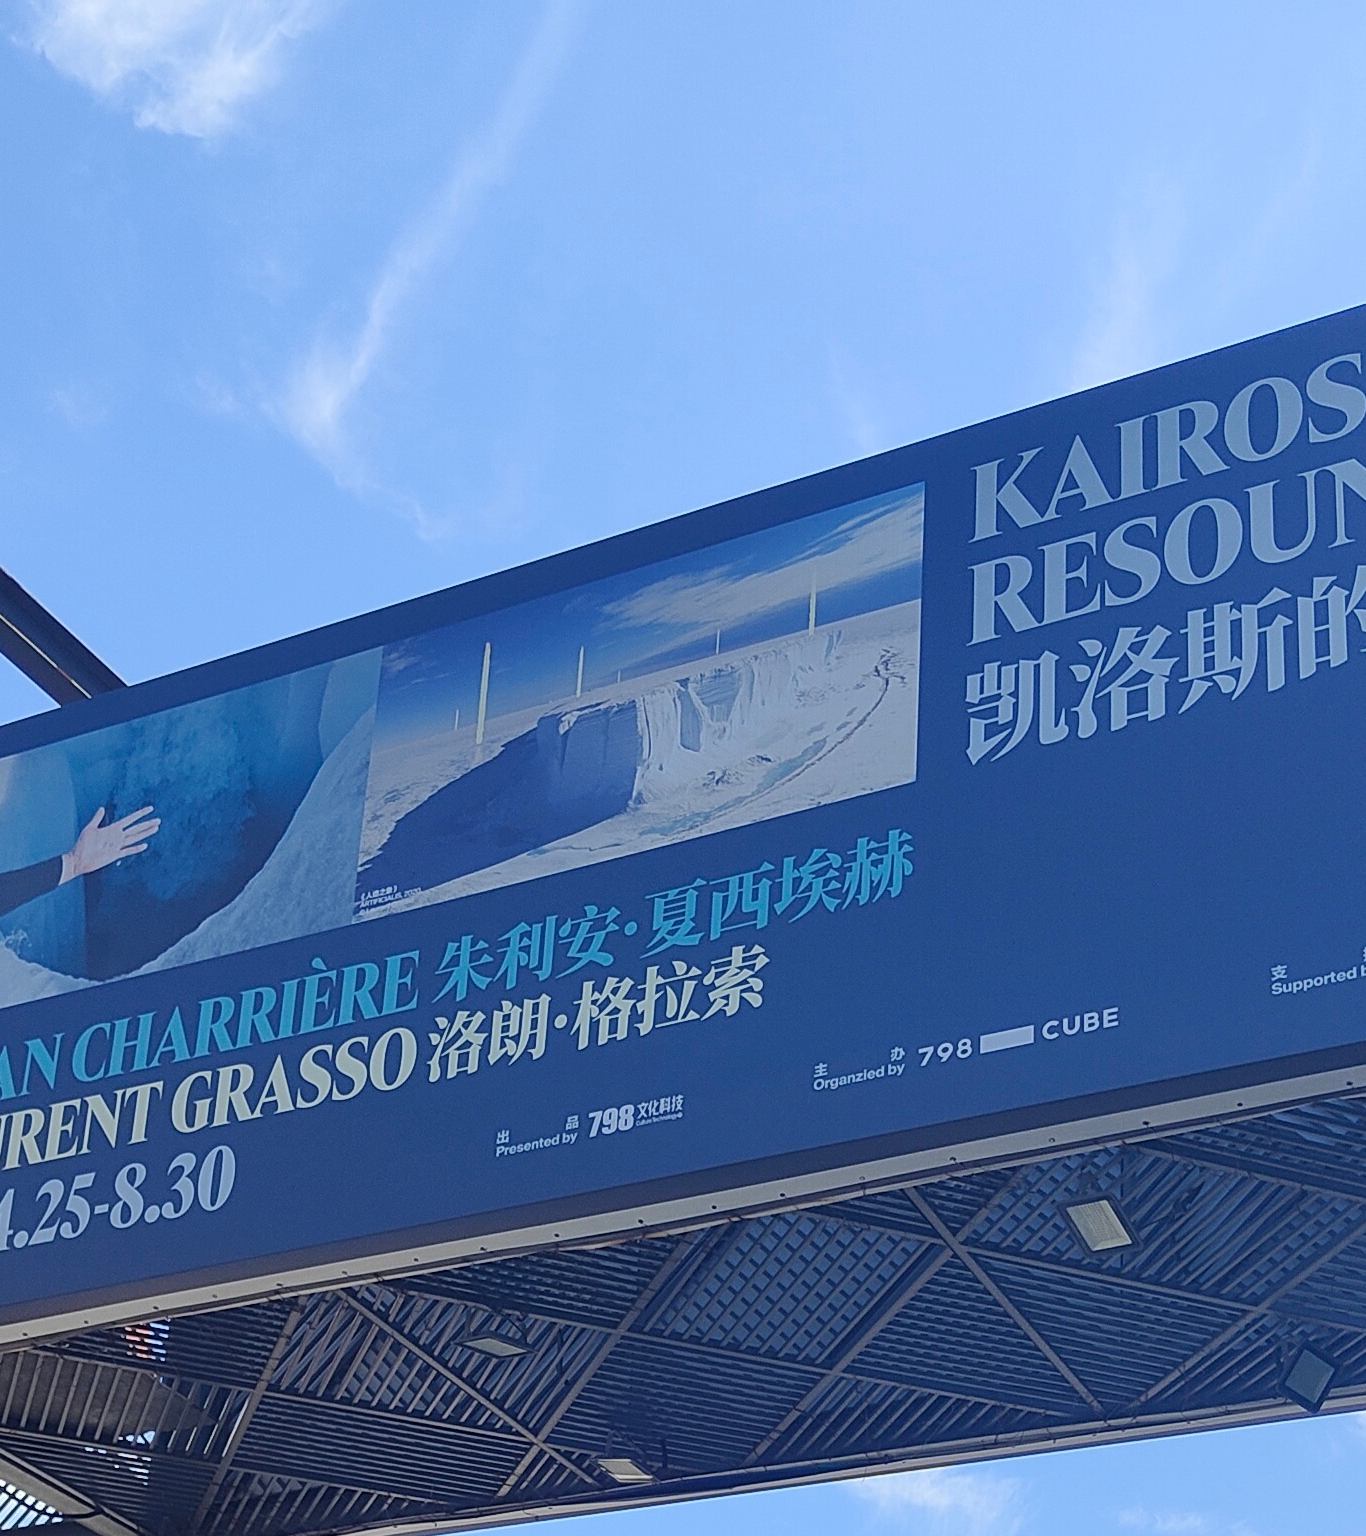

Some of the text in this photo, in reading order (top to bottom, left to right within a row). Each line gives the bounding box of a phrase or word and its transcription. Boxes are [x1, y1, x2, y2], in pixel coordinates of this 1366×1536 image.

[1271, 966, 1357, 995] Supported
[72, 950, 420, 1082] CHARRIÈRE
[427, 944, 770, 1083] 洛朗·格拉索
[918, 1007, 1120, 1067] 798 CUBE
[171, 1027, 418, 1133] GRASSO
[813, 1061, 905, 1091] Organzied by
[588, 1094, 684, 1138] 798 文化科技
[496, 1132, 578, 1157] Presented by
